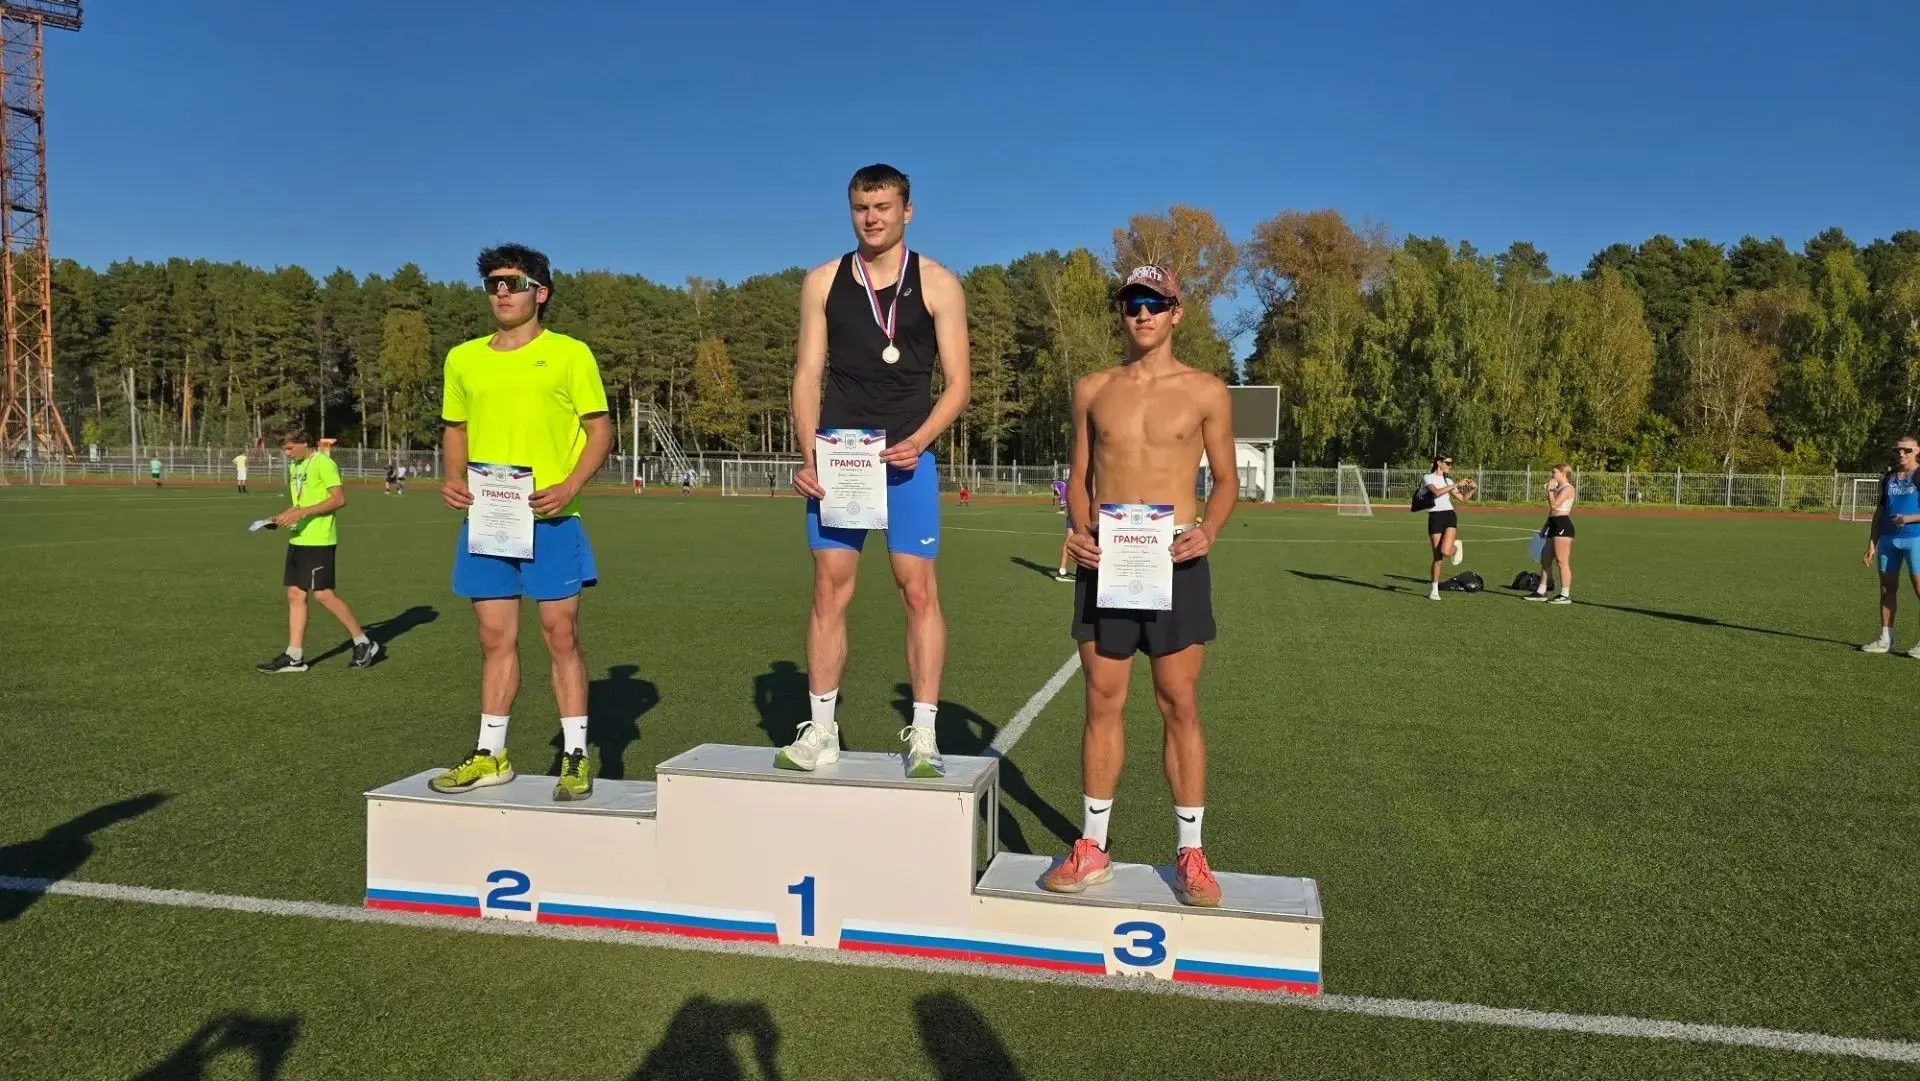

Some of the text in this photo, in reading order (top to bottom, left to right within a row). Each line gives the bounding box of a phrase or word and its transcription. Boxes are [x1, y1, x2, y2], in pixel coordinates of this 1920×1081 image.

[830, 459, 872, 468] ГРАМОТА
[482, 489, 521, 500] ГРАМОТА
[1113, 535, 1158, 544] ГРАМОТА
[486, 869, 531, 912] 2
[787, 876, 815, 936] 1
[1113, 921, 1167, 967] 3
